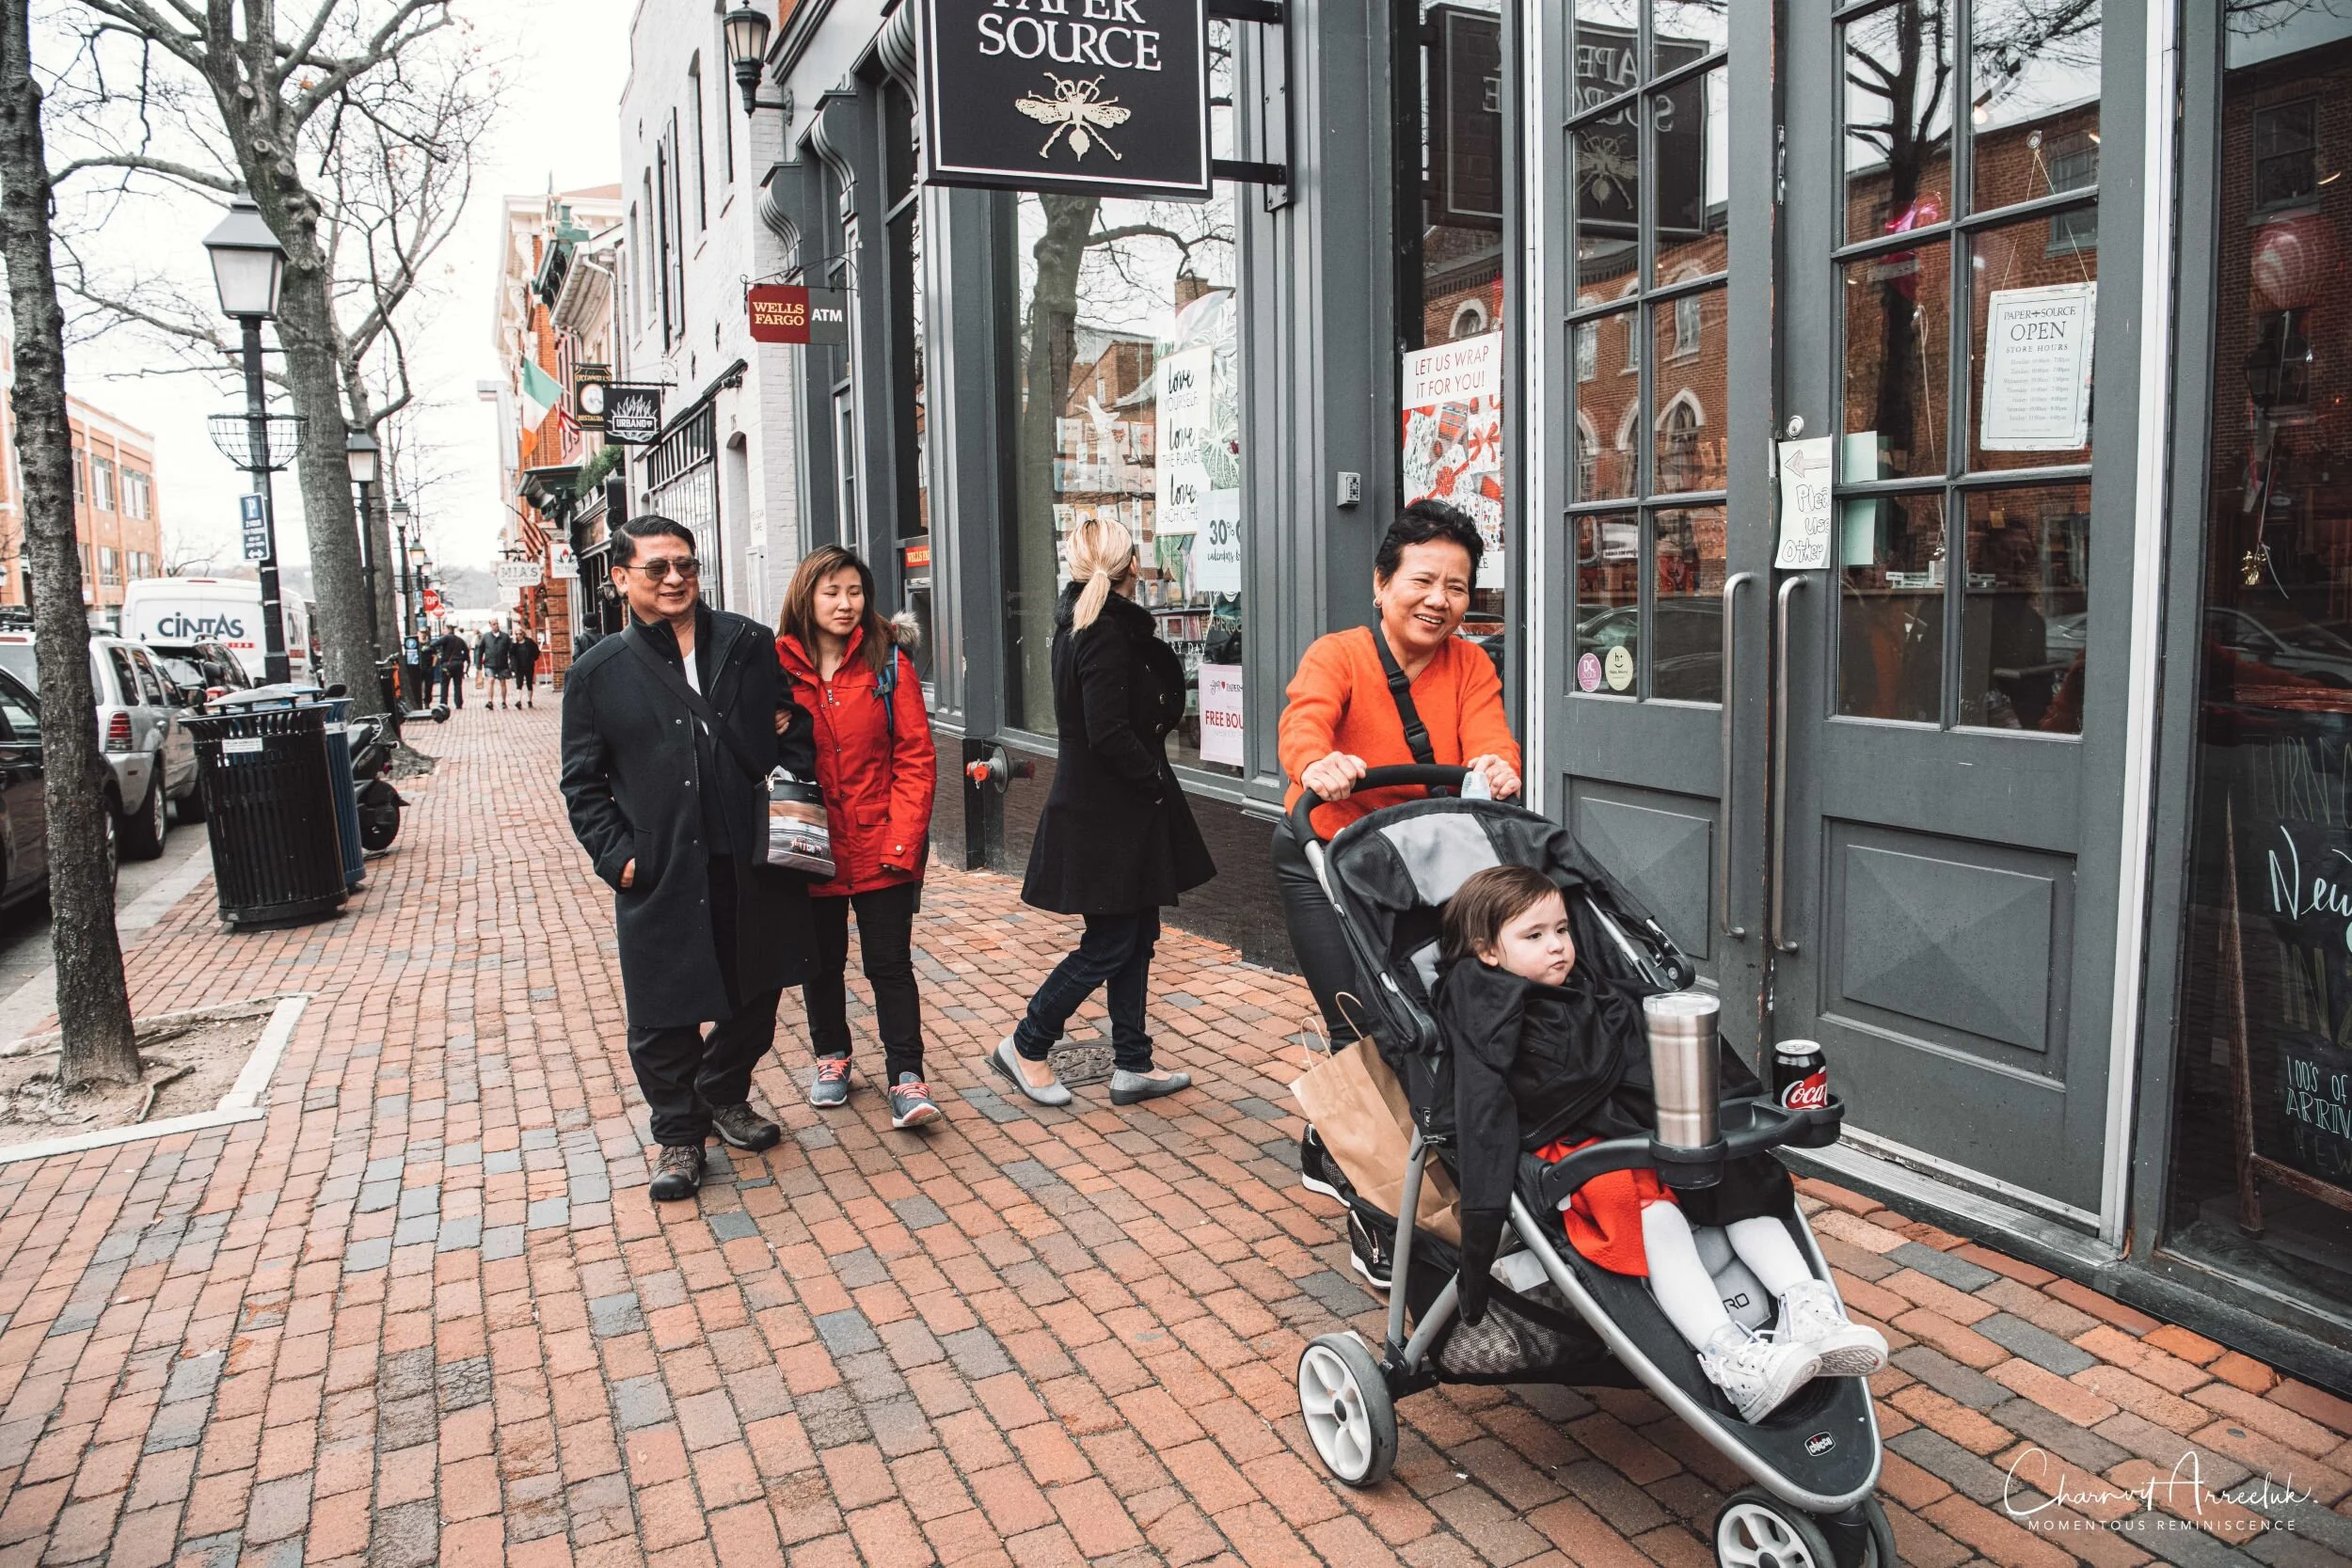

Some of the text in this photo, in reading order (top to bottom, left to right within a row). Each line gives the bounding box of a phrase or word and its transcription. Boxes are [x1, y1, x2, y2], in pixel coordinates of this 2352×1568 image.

[977, 13, 1162, 71] SOURCE
[753, 301, 804, 313] WELLS
[811, 309, 843, 322] ATM
[2004, 310, 2032, 320] PAPER
[755, 313, 804, 326] FARGO
[2010, 321, 2066, 341] OPEN
[2006, 345, 2033, 354] STORE
[1415, 345, 1488, 376] LET US WRAP
[1168, 361, 1195, 394] love
[1417, 371, 1485, 399] IT FOR YOU!
[616, 419, 646, 428] URBANO
[1169, 418, 1196, 451] love
[1162, 449, 1200, 467] THE PLANE
[1170, 474, 1196, 506] love
[1209, 519, 1234, 546] 30%
[1782, 538, 1823, 562] Other
[423, 595, 437, 605] TOP
[1188, 642, 1206, 656] DAY
[1583, 659, 1595, 672] DC
[1205, 710, 1224, 727] FREE
